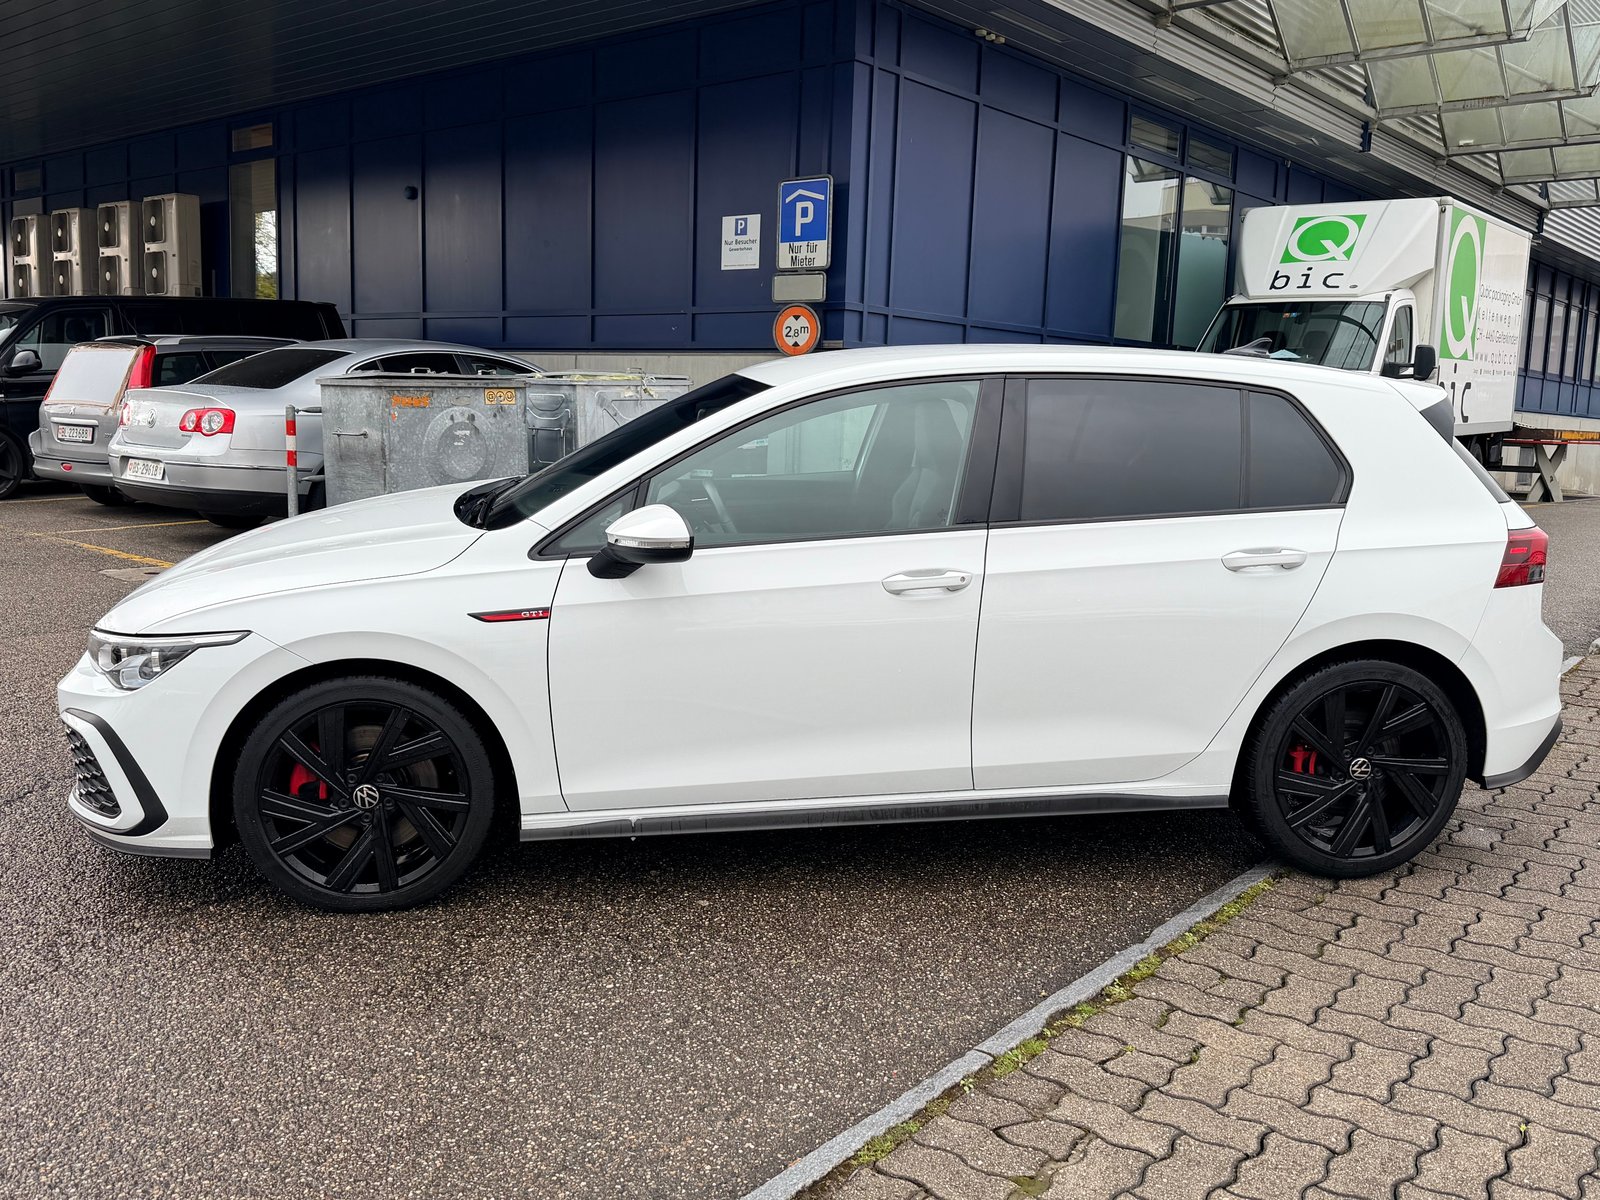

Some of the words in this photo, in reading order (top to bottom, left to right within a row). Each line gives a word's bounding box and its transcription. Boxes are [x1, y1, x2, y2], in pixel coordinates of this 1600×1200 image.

[795, 201, 814, 237] P
[737, 220, 745, 234] P
[734, 238, 758, 246] Besucher
[1287, 215, 1360, 262] Q
[788, 243, 802, 254] Nur
[806, 242, 818, 253] für
[790, 255, 816, 267] Mieter
[521, 610, 544, 618] GTI
